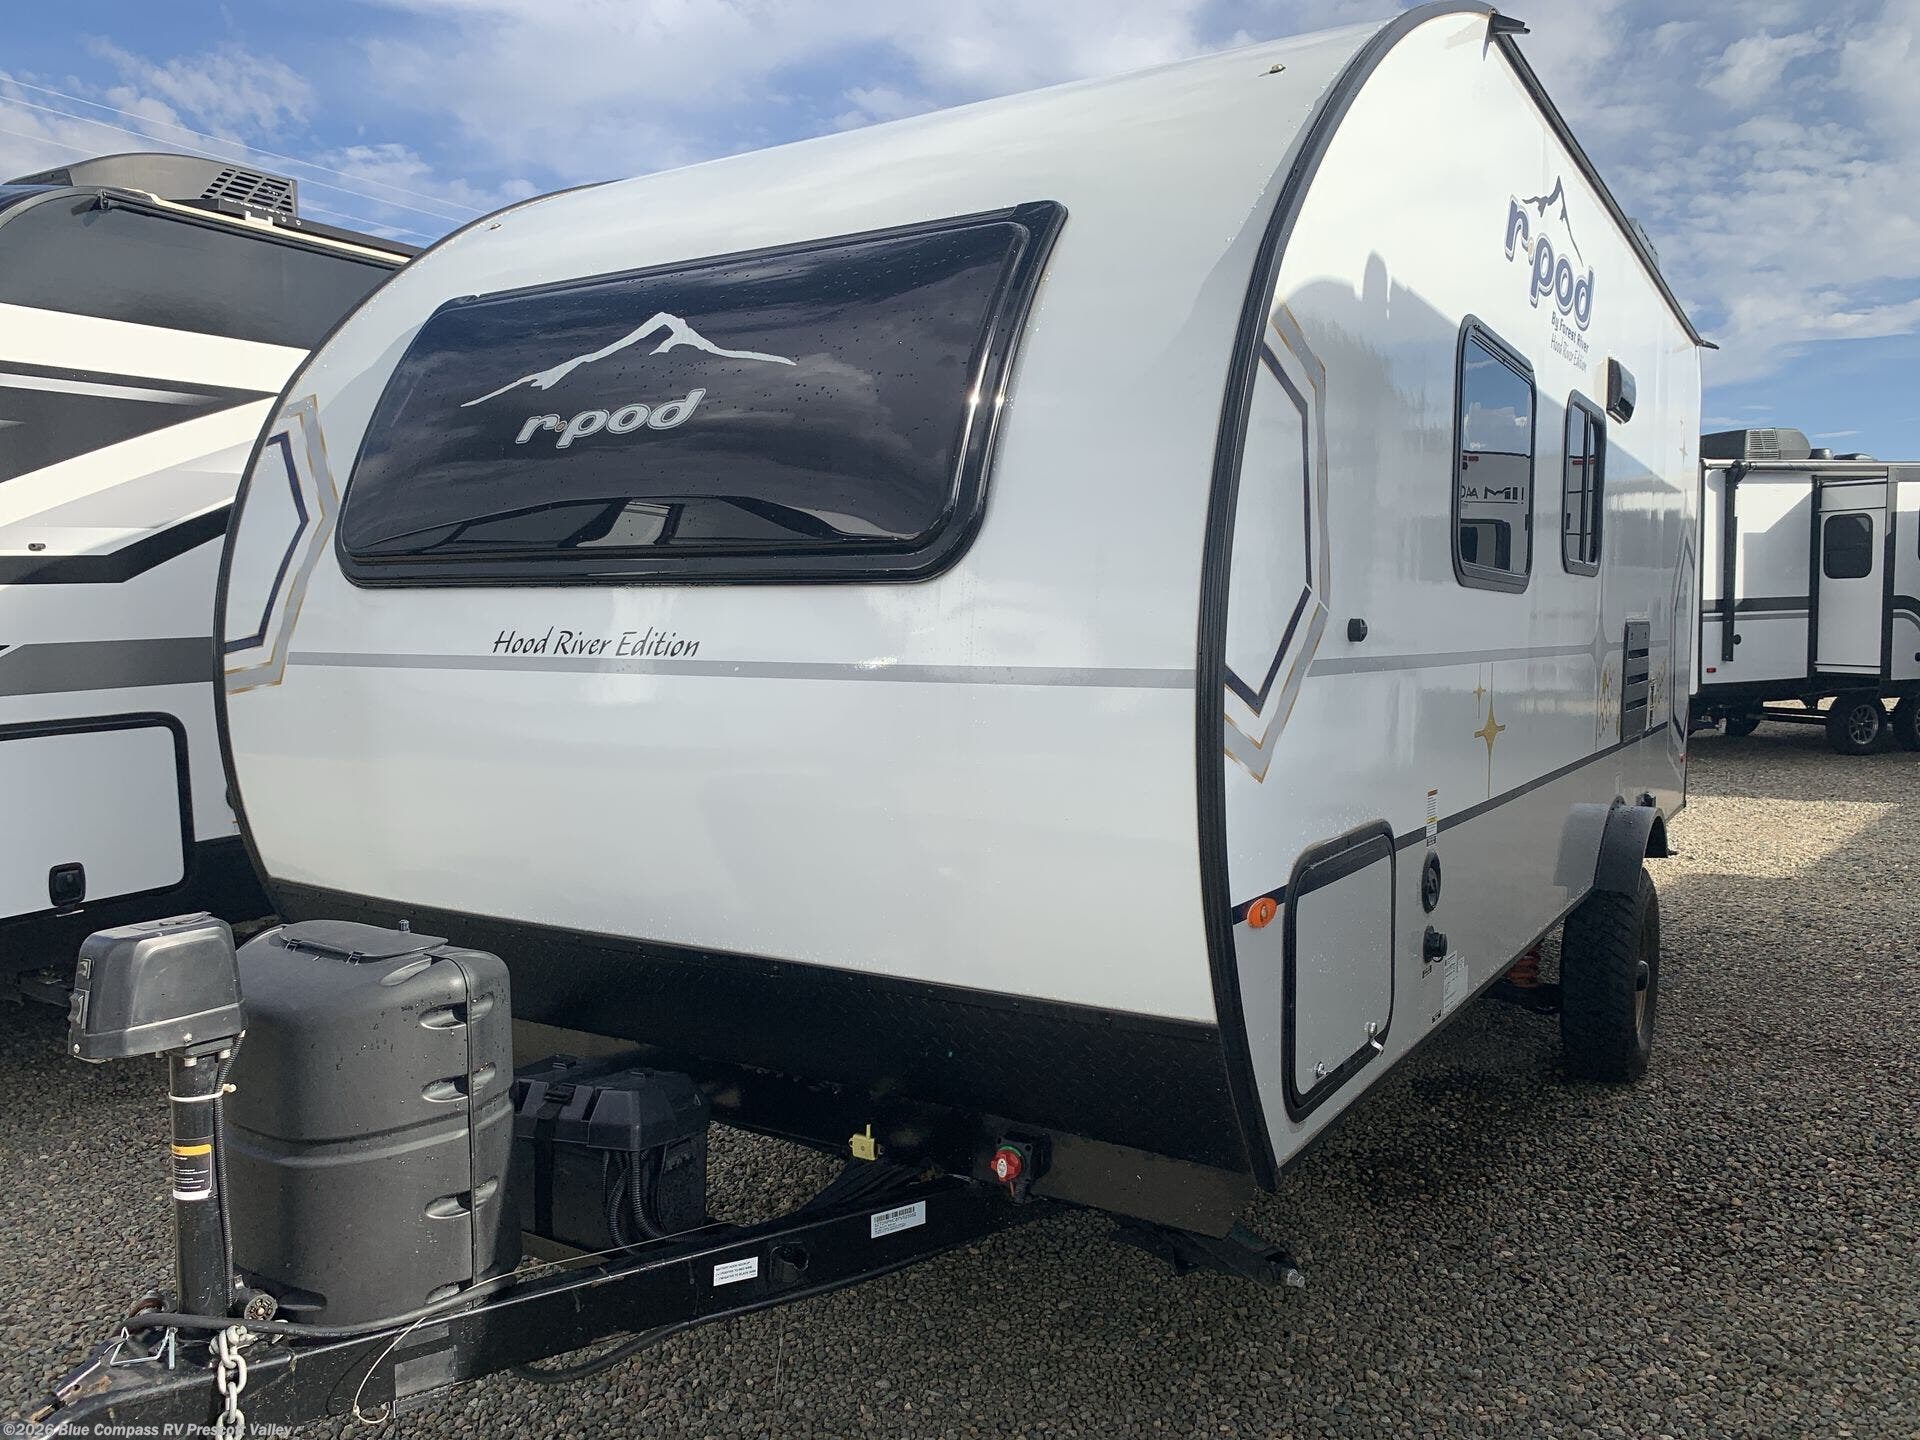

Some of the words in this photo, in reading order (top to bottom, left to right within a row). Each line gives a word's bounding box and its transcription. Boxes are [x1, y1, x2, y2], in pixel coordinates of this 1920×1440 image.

[1559, 318, 1577, 344] Forest
[492, 625, 555, 654] Hood
[553, 629, 612, 655] River
[615, 626, 701, 657] Edition
